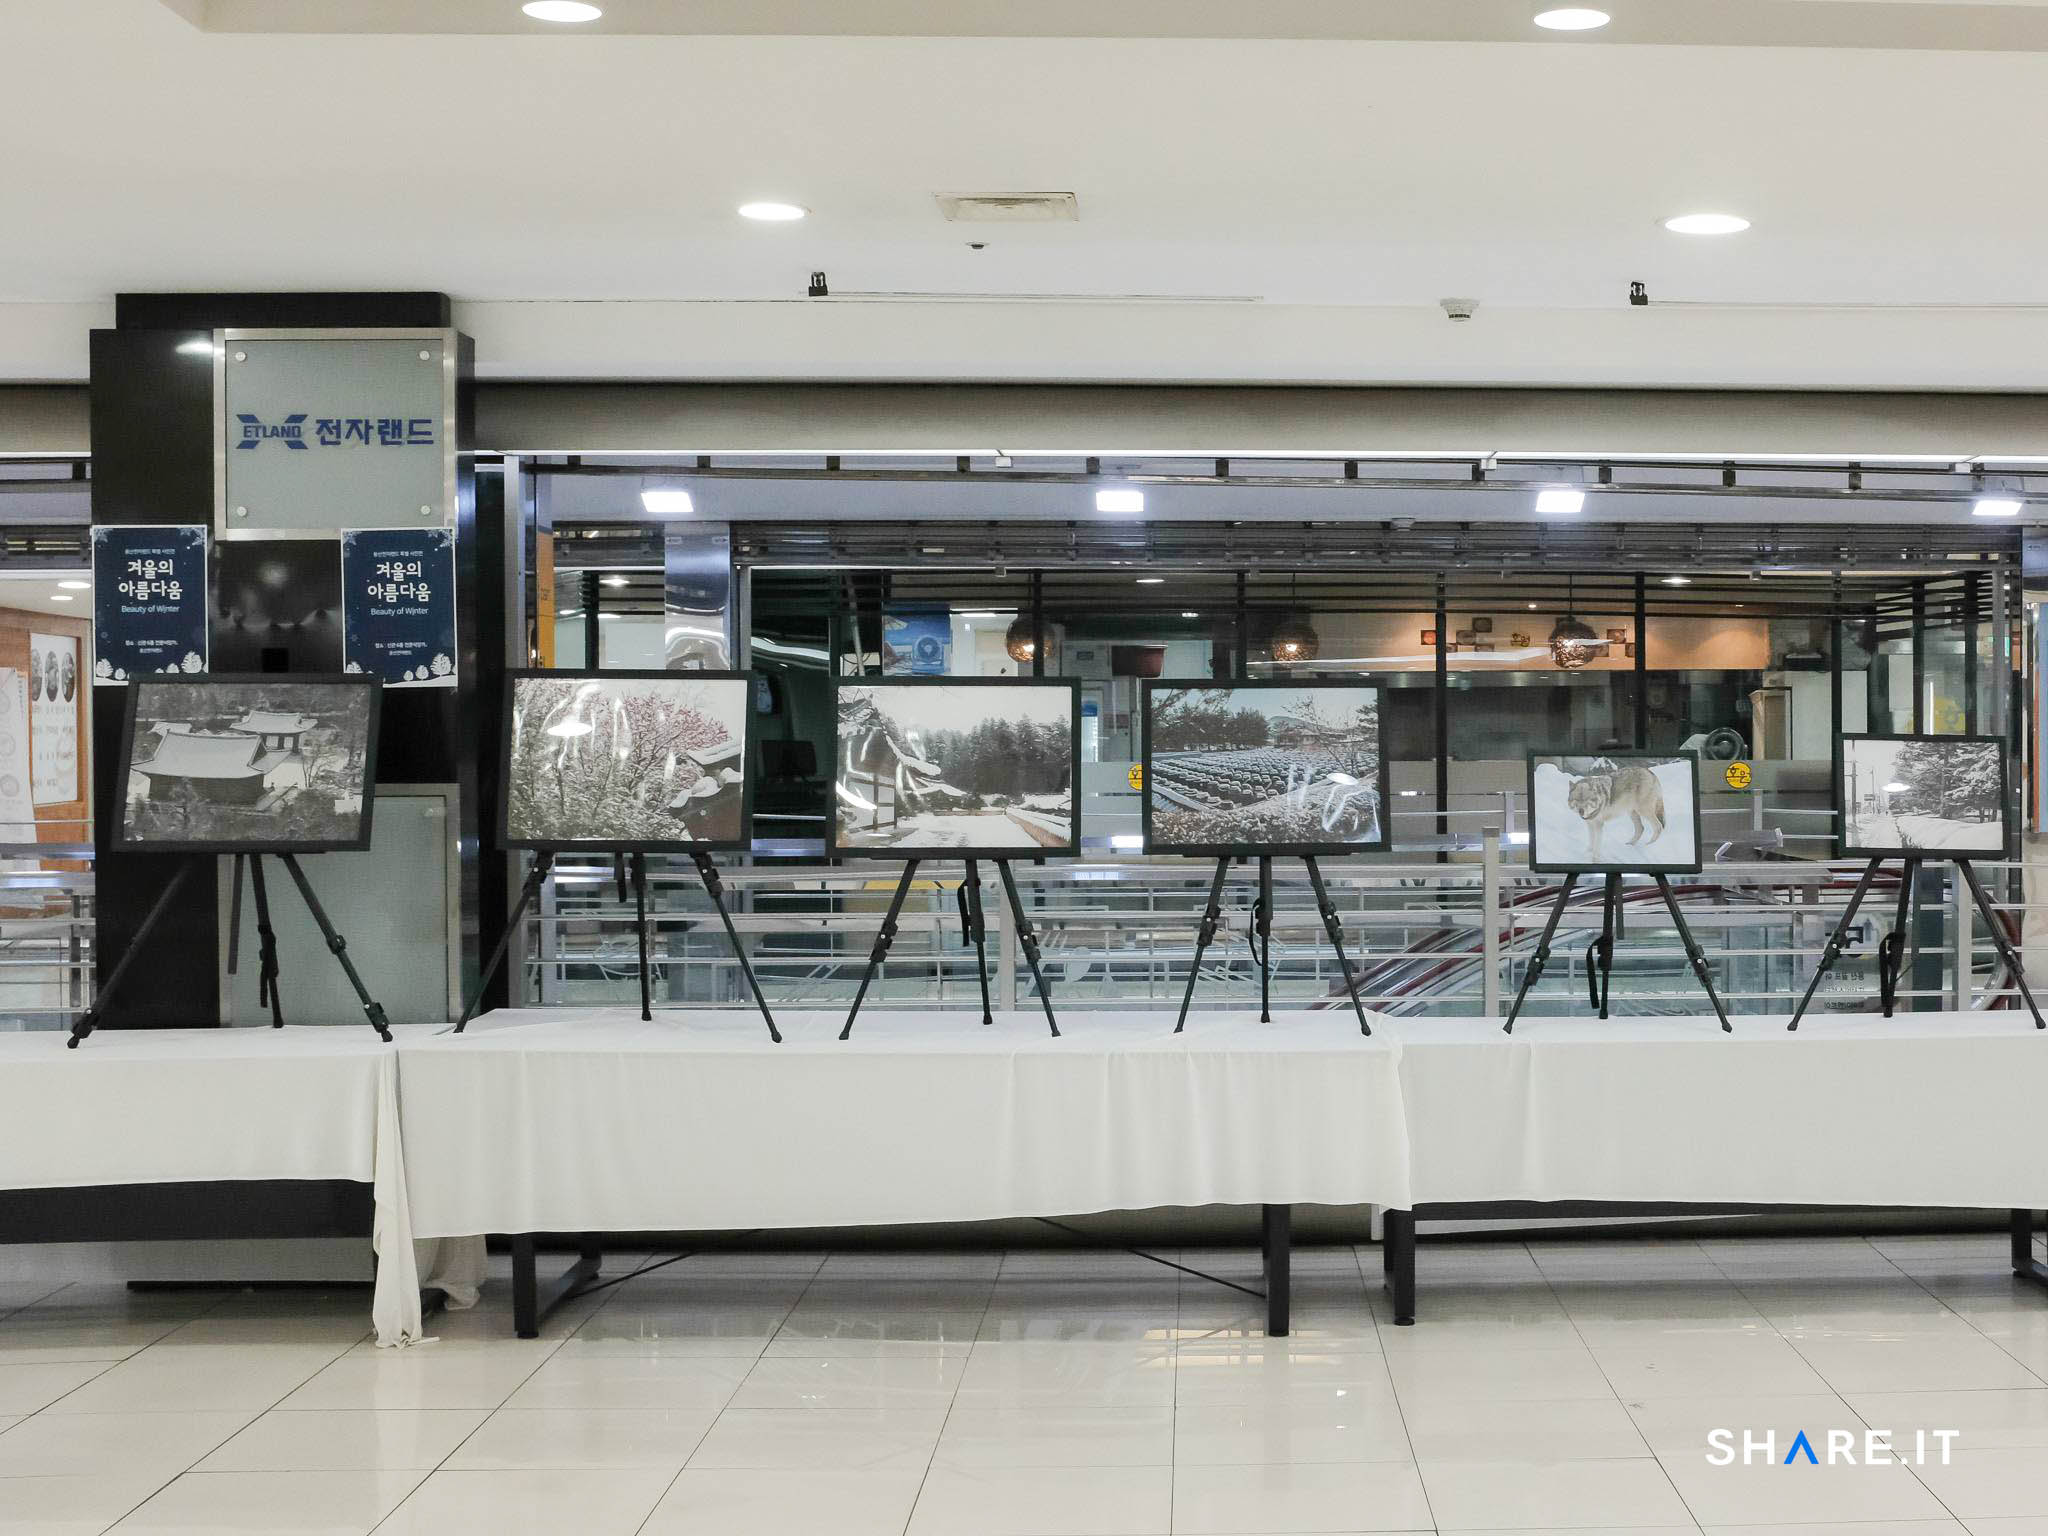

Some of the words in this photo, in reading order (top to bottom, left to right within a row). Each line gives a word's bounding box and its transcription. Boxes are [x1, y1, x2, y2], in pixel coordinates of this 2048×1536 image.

[243, 425, 301, 438] ETLAND
[315, 419, 434, 446] 전자랜드
[127, 559, 173, 579] 겨울의
[376, 561, 422, 582] 겨울의
[118, 580, 183, 600] 아름다움
[367, 582, 432, 603] 아름다움
[121, 605, 147, 614] Beauty
[156, 605, 180, 613] Winter
[370, 608, 395, 616] Beauty
[405, 607, 429, 616] Winter
